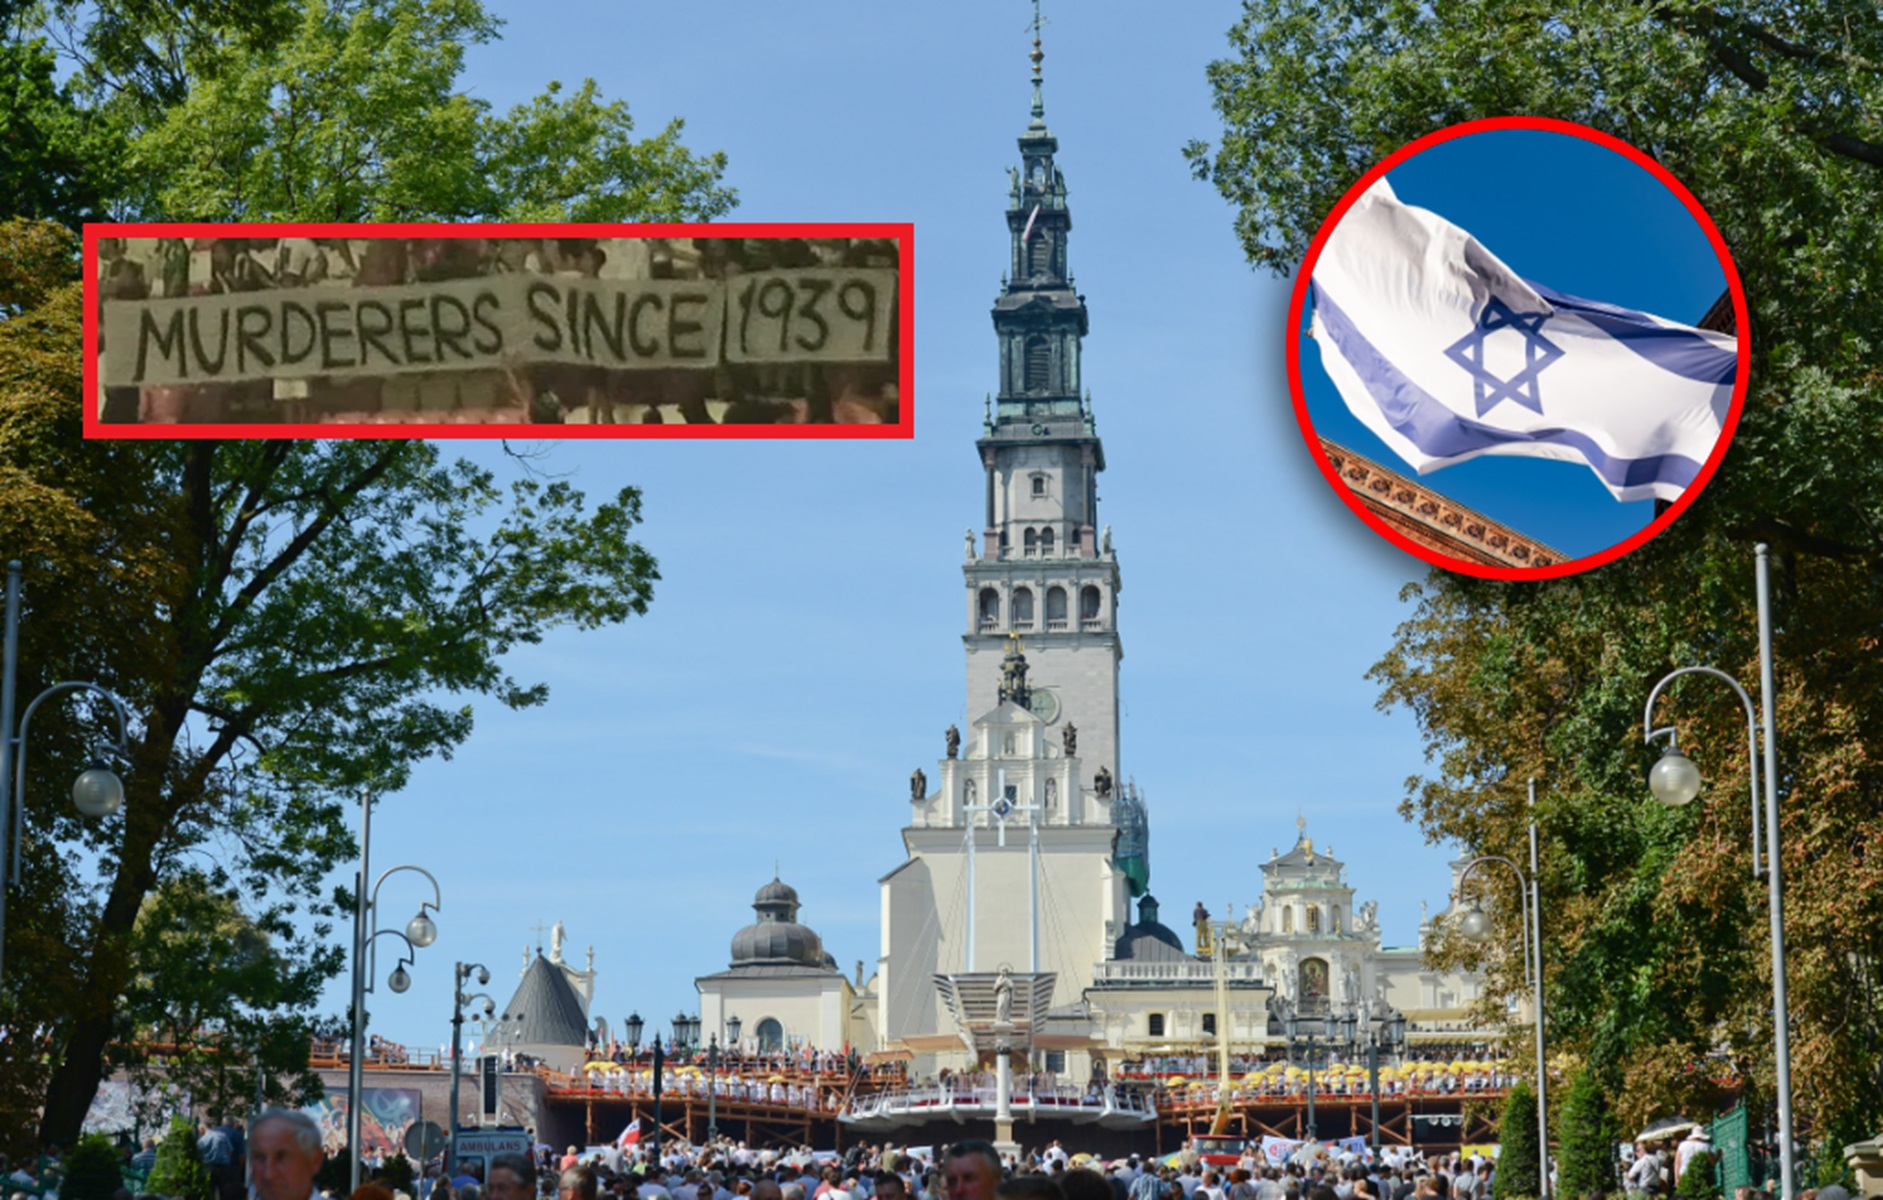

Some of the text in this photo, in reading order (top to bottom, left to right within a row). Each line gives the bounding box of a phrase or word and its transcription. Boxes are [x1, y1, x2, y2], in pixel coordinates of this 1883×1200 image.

[132, 277, 876, 382] MURDERERS SINCE 1939
[460, 1141, 522, 1152] AMBULANS
